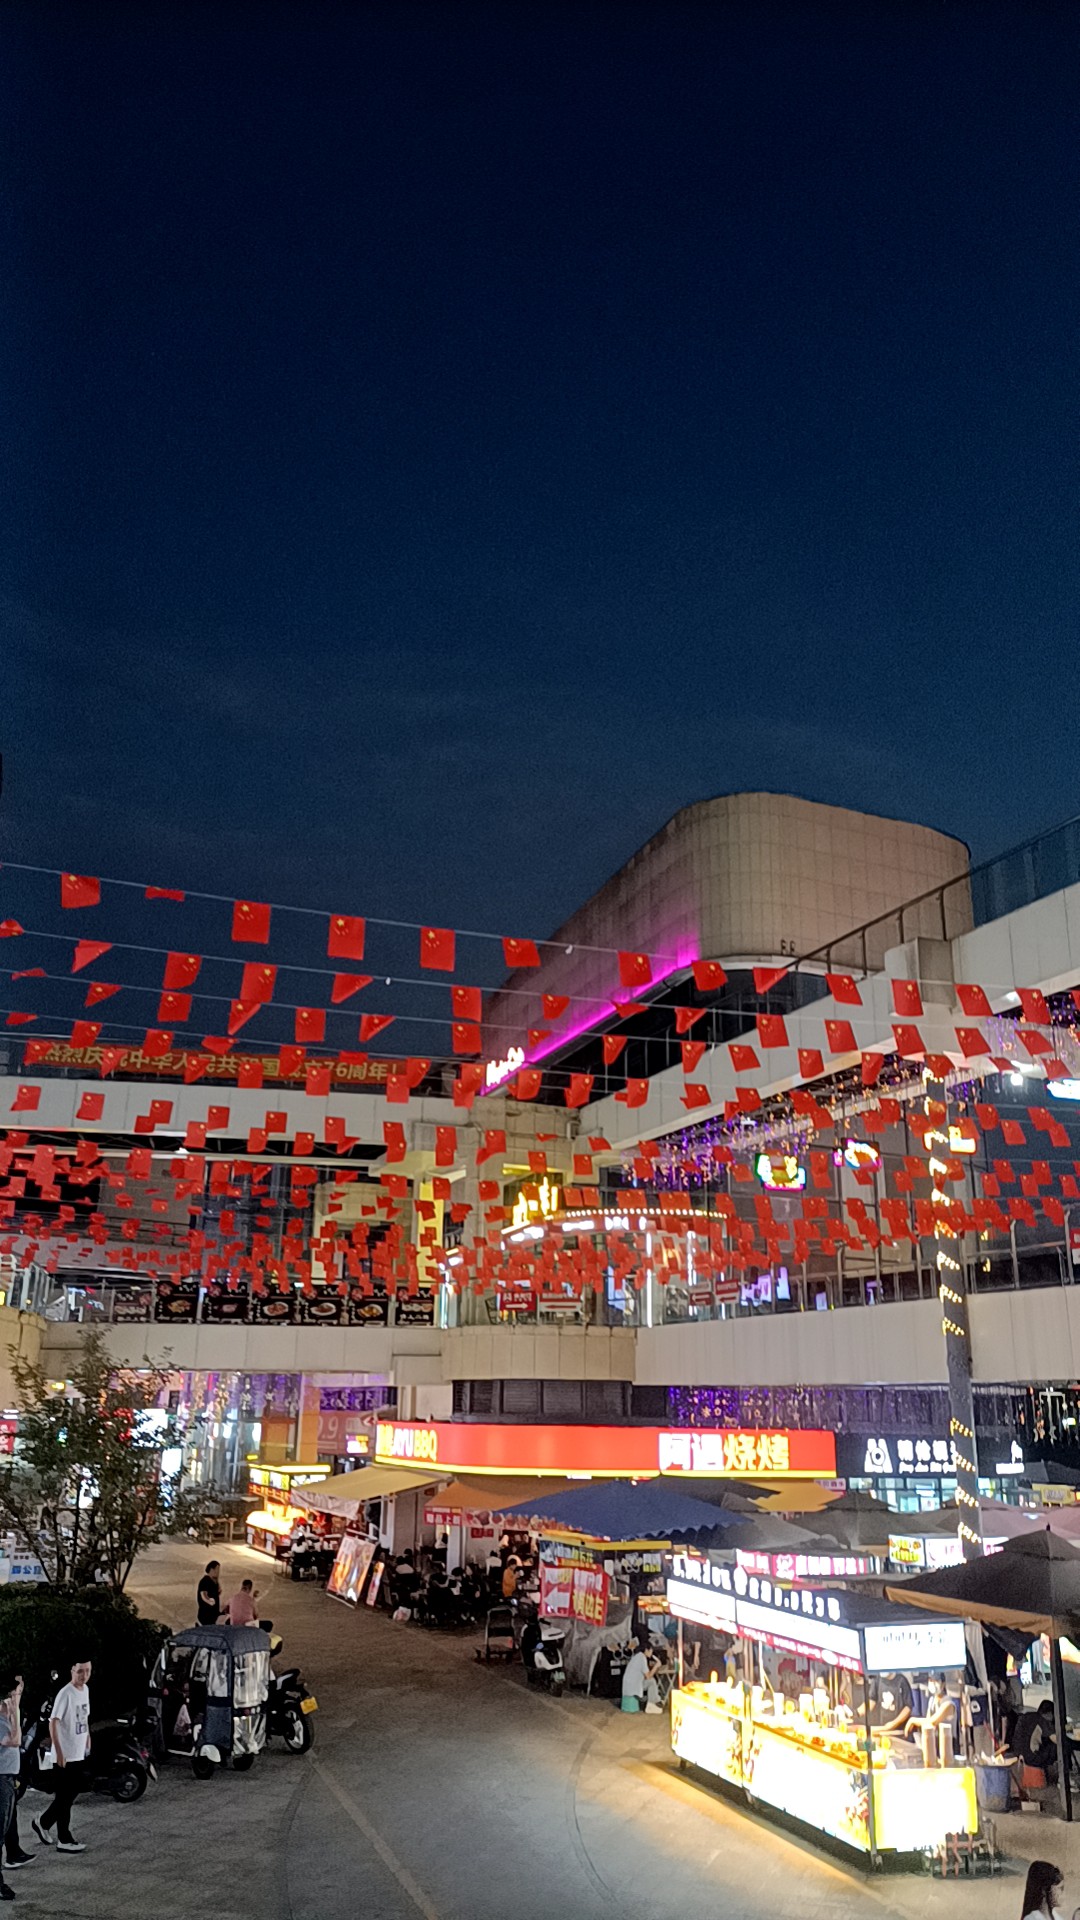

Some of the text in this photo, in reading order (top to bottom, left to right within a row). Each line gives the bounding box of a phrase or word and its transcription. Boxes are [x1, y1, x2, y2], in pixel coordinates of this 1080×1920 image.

[414, 1429, 437, 1462] BBQ
[659, 1433, 789, 1471] 阿遇烧烤
